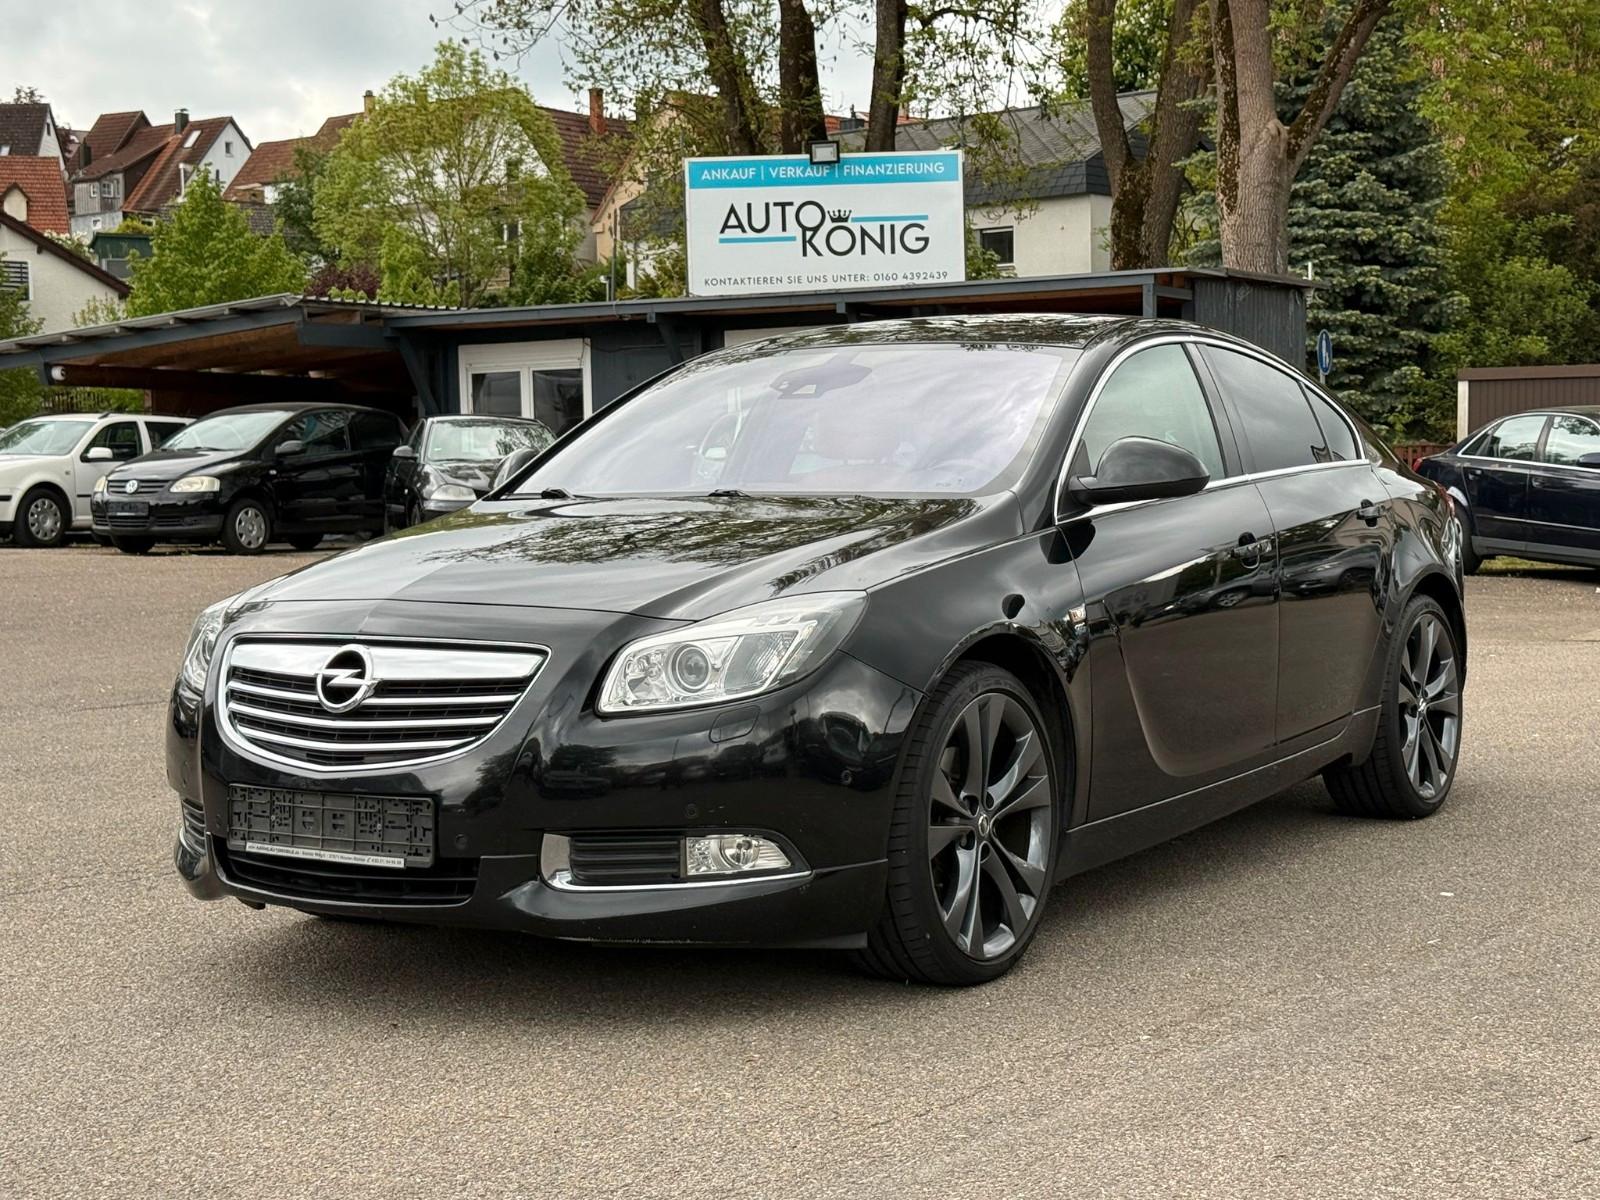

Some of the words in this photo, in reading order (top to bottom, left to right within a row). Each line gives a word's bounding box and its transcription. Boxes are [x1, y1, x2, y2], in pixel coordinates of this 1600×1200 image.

[701, 167, 757, 181] ANKAUF
[769, 164, 831, 178] VERKAUF
[843, 161, 945, 176] FINANZIERUNG
[720, 200, 826, 234] AUTO
[704, 276, 783, 286] KONTAKTIEREN
[787, 275, 803, 284] SIE
[807, 274, 828, 283] UNS
[832, 273, 870, 282] UNTER:
[873, 271, 898, 281] 0160
[902, 271, 949, 281] 4392439
